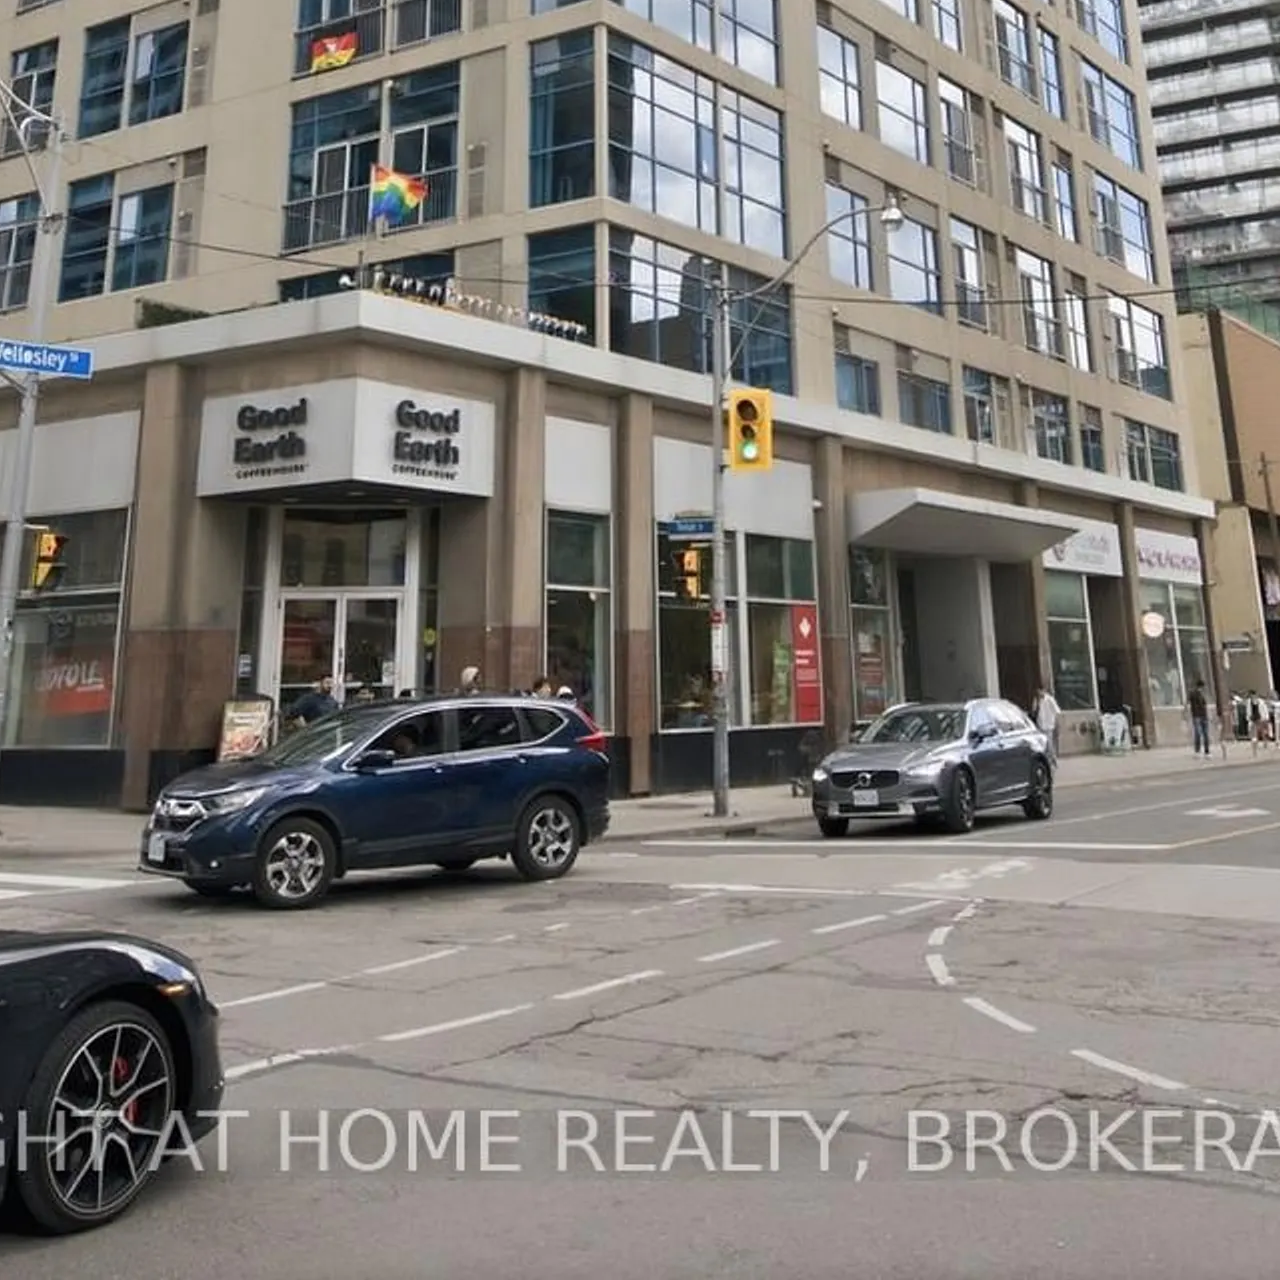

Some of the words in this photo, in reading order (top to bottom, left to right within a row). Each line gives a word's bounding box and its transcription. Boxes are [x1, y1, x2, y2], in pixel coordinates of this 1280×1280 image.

[237, 397, 308, 431] Good
[395, 399, 460, 434] Good
[234, 431, 306, 464] Earth
[393, 430, 459, 465] Earth
